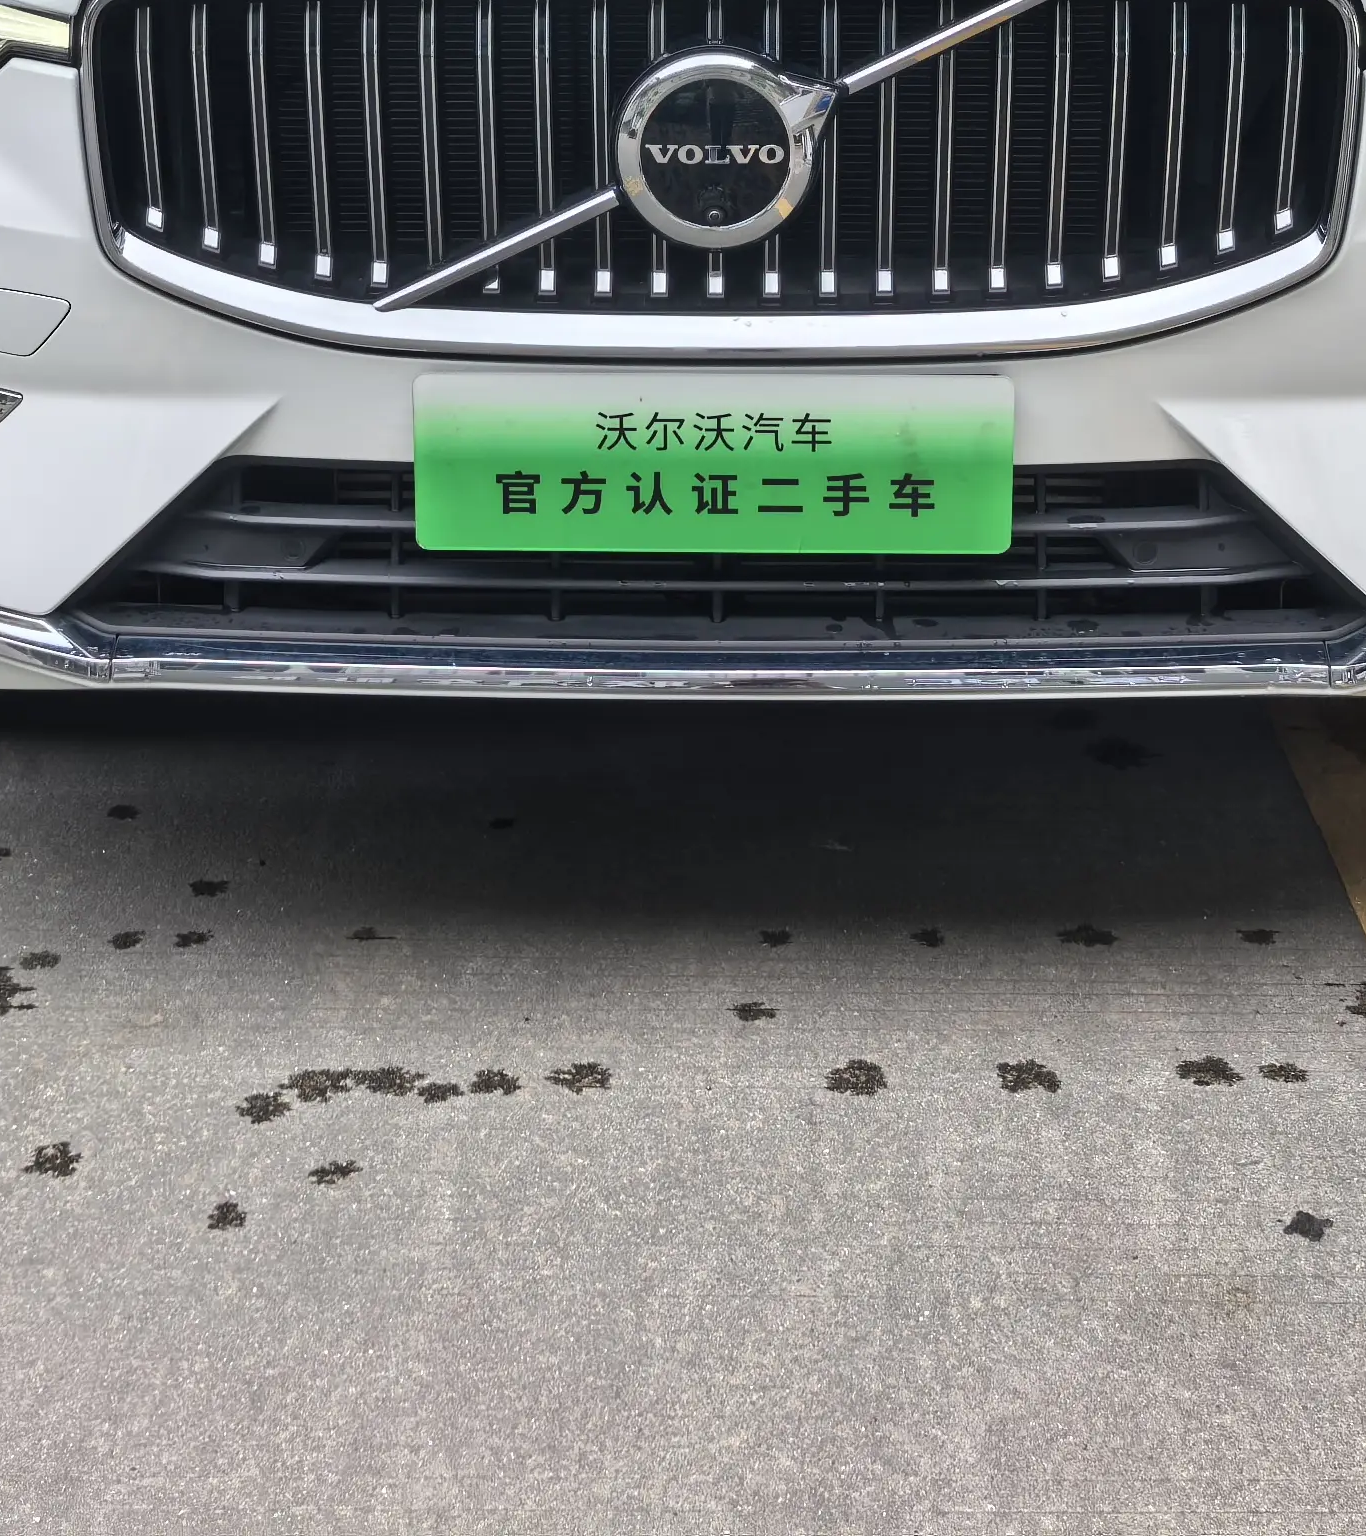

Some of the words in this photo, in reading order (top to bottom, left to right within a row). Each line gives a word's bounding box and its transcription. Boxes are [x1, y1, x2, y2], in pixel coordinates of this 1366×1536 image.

[645, 144, 785, 164] VOLVO
[595, 411, 833, 453] 沃尔沃汽车
[495, 470, 937, 518] 官方认证二手车
